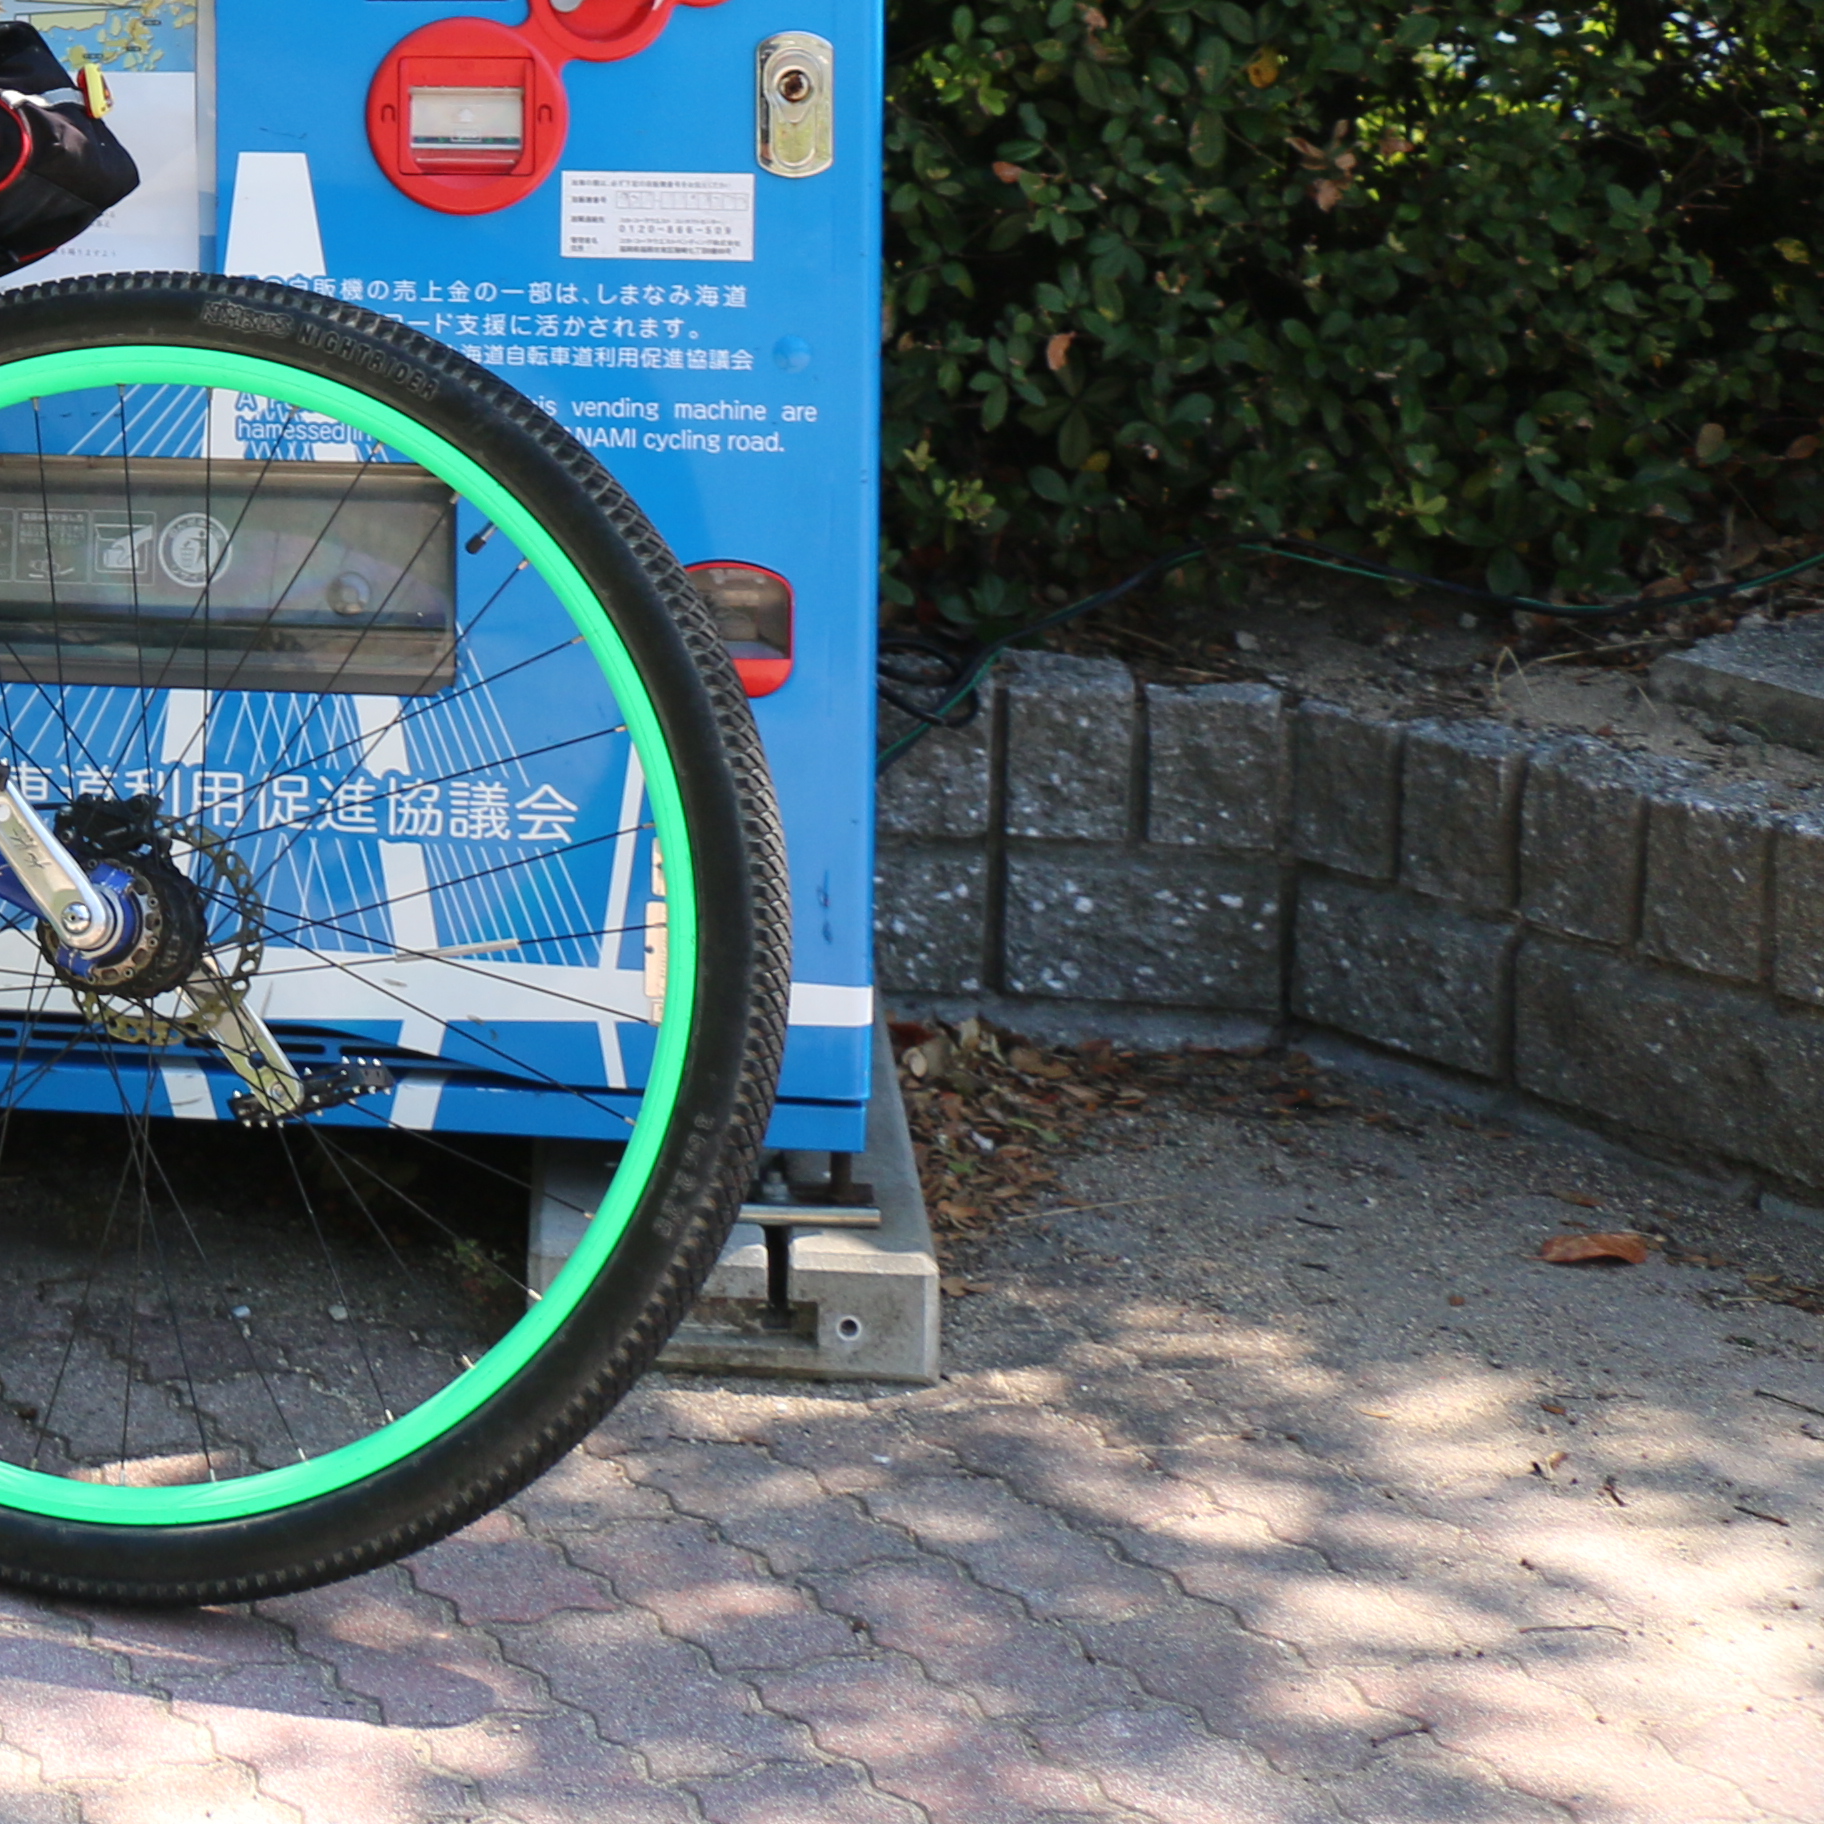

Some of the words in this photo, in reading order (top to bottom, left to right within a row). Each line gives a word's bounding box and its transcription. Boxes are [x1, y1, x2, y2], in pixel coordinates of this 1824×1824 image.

[297, 323, 441, 397] NIGHTRIDER
[571, 396, 660, 420] vending
[674, 398, 767, 421] machine
[781, 404, 818, 422] are
[643, 430, 721, 455] cycling
[727, 431, 786, 453] road.
